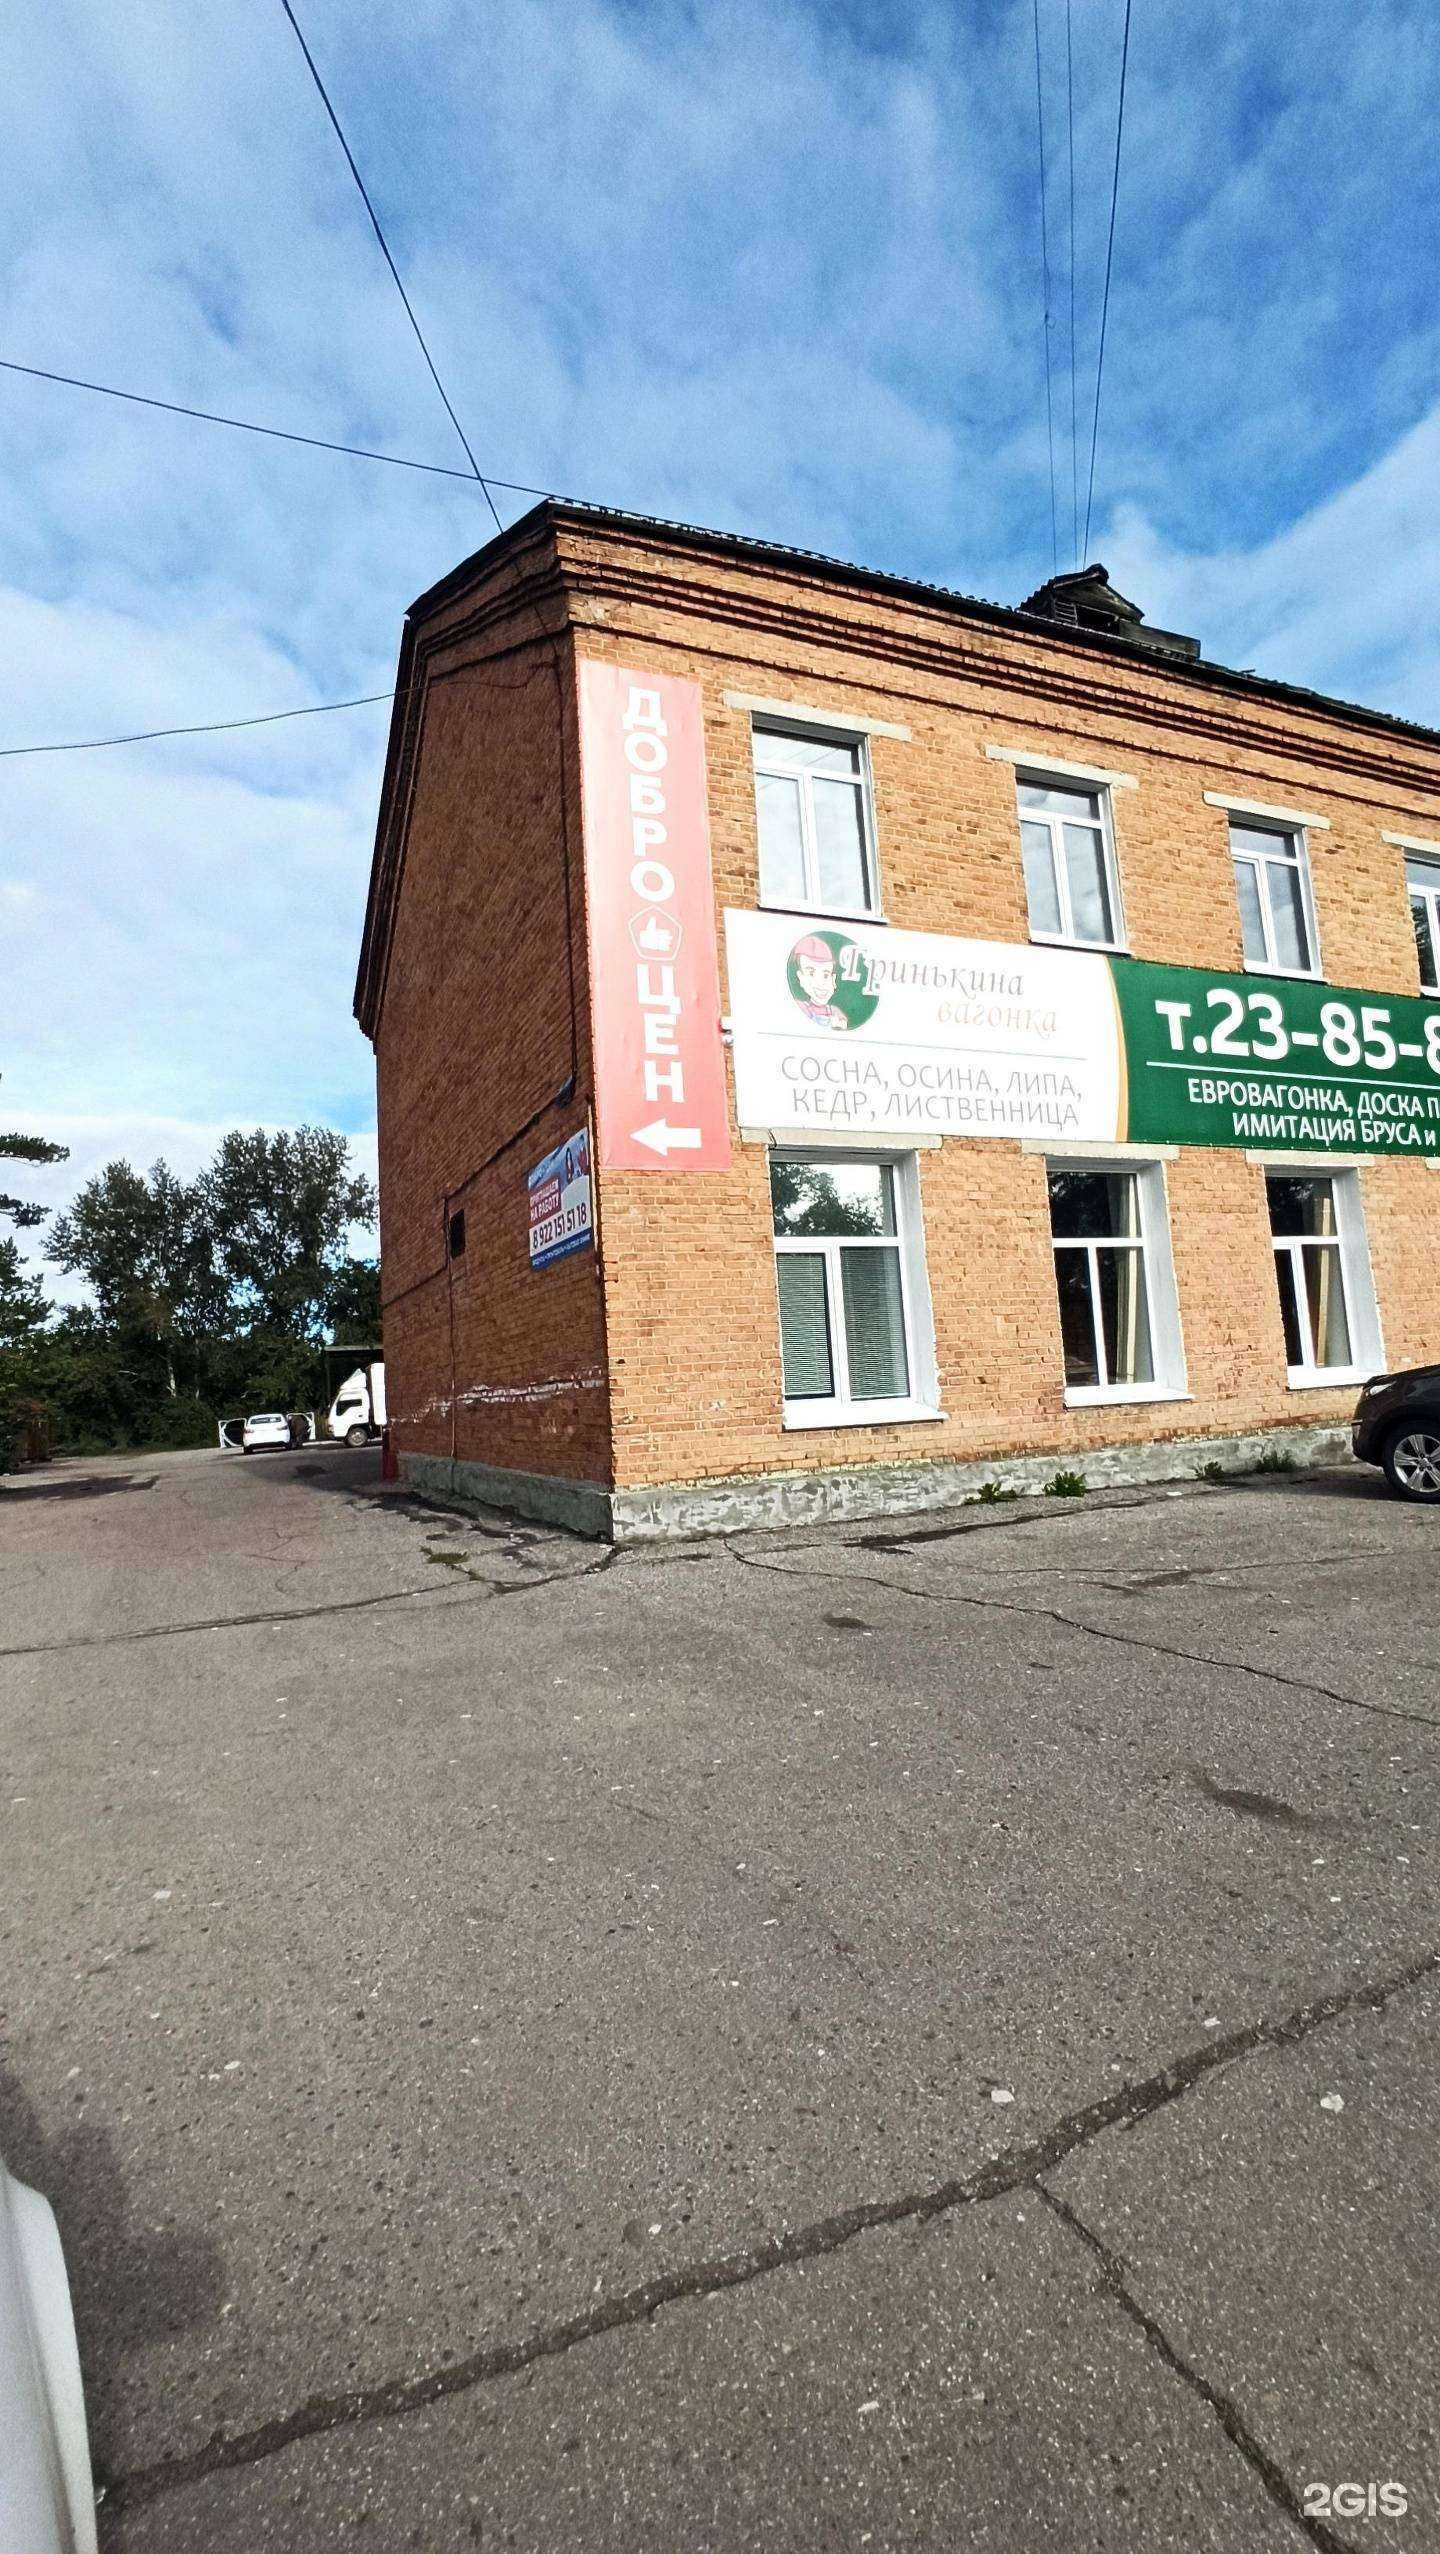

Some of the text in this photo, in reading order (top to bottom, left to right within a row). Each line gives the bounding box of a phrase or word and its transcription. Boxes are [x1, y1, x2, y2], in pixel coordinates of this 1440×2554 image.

[937, 1000, 1058, 1040] вагонка
[781, 1056, 1083, 1101] СОСНА, ОСИНА, ЛИПА,
[1187, 1078, 1354, 1118] ЕВРОВАГОНКА,
[1357, 1091, 1425, 1120] ДОСКА
[793, 1087, 1080, 1133] КЕДР, ЛИСТВЕННИЦА
[1232, 1112, 1356, 1147] ИМИТАЦИЯ
[1361, 1120, 1422, 1146] БРУСА
[533, 1202, 587, 1249] 8 922 151 51 18
